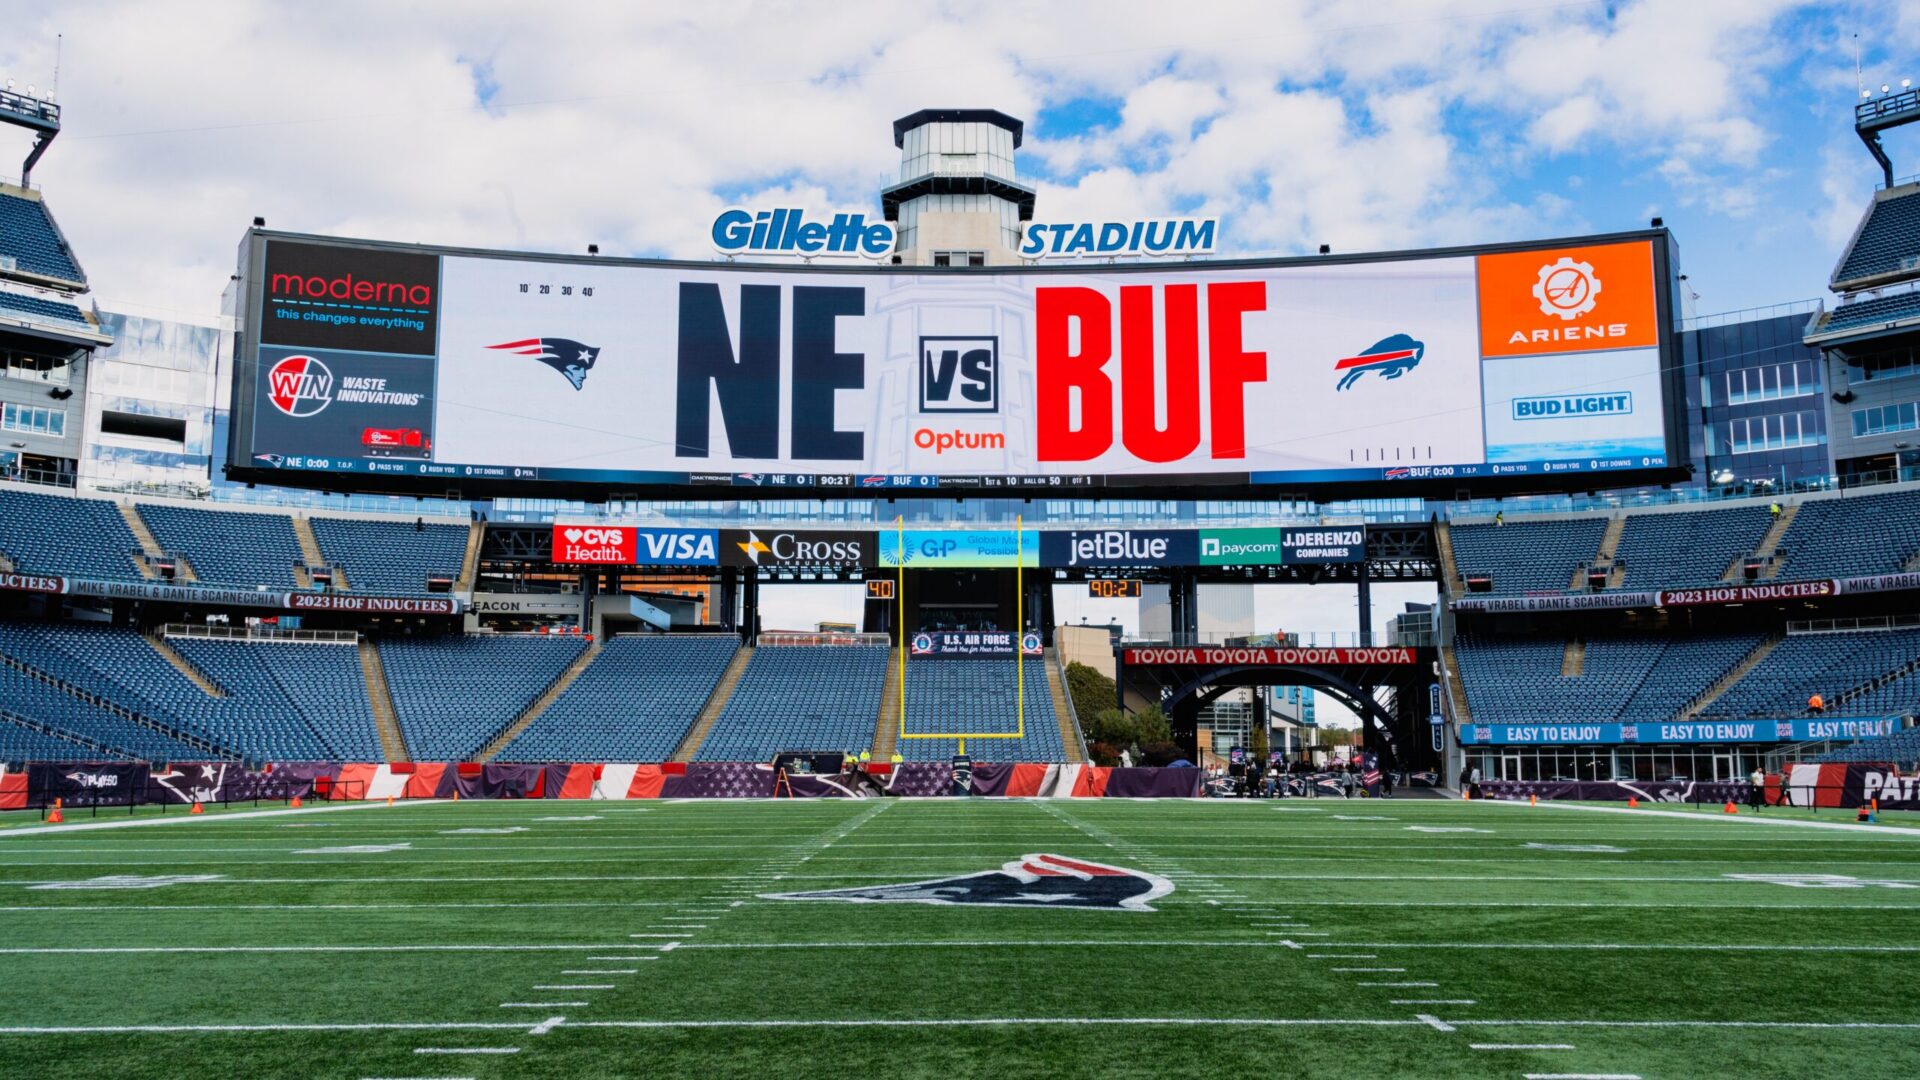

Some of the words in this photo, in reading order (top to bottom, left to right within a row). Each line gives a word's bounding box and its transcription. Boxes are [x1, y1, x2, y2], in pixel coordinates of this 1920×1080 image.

[712, 208, 894, 253] Gillette
[1022, 220, 1217, 255] STADIUM
[272, 273, 431, 305] moderna
[276, 308, 300, 320] this
[303, 312, 357, 325] changes
[360, 317, 425, 331] everything
[1508, 323, 1628, 344] ARIENS
[675, 281, 866, 460] NE
[925, 348, 993, 403] VS
[1036, 281, 1268, 463] BUF
[274, 371, 328, 399] WIN
[342, 376, 387, 391] WASTE
[336, 388, 419, 406] INNOVATIONS
[1516, 400, 1562, 417] BUD
[1565, 395, 1628, 414] LIGHT
[914, 428, 1006, 454] Optum
[287, 456, 302, 467] NE
[306, 458, 329, 468] 0:00
[369, 462, 376, 471] 0
[420, 464, 427, 473] 0
[465, 466, 472, 475] 0
[514, 468, 521, 477] 0
[1410, 467, 1431, 477] BUF
[1433, 466, 1454, 476] 0:00
[1492, 465, 1499, 474] 0
[1543, 462, 1551, 472] 0
[1591, 460, 1598, 469] 0
[1643, 457, 1650, 466] 0
[772, 475, 786, 484] NE
[796, 475, 805, 484] 0
[820, 476, 850, 485] 90:21
[893, 476, 912, 485] BUF
[920, 476, 929, 485] 0
[1006, 476, 1017, 485] 10
[1049, 476, 1061, 485] 50
[1086, 476, 1091, 485] 1
[583, 529, 623, 545] CVS
[640, 533, 716, 559] VISA
[967, 535, 999, 544] Global
[1002, 536, 1030, 545] Mae
[1282, 531, 1362, 547] J.DERENZO
[921, 539, 957, 558] GP
[1068, 531, 1168, 566] jetBlue
[1222, 542, 1277, 556] paycom
[1296, 548, 1349, 558] COMPANIES
[77, 580, 105, 594] MIKE
[109, 582, 149, 598] VRABEL
[152, 586, 160, 598] &
[163, 585, 198, 600] DANTE
[202, 589, 276, 605] SCARNECCHIA
[869, 581, 893, 597] 40
[1091, 581, 1140, 597] 90:21
[1667, 591, 1702, 604] 2023
[1705, 588, 1738, 602] HOF
[1742, 582, 1829, 599] INDUCTEES
[1849, 576, 1876, 592] MIKE
[296, 594, 331, 608] 2023
[333, 596, 364, 610] HOF
[367, 597, 448, 612] INDUCTEES
[1460, 600, 1485, 610] MIKE
[1488, 599, 1525, 611] VRABEL
[1528, 599, 1535, 609] &
[1538, 597, 1570, 609] DANTE
[1574, 594, 1647, 608] SCARNECCHIA
[944, 634, 962, 645] U.S.
[965, 634, 980, 645] AIR
[983, 634, 1010, 645] FORCE
[1132, 649, 1197, 664] TOYOTA
[1203, 649, 1268, 664] TOYOTA
[1274, 649, 1339, 664] TOYOTA
[1345, 649, 1411, 664] TOYOTA
[1507, 727, 1538, 741] EASY
[1541, 727, 1558, 741] TO
[1560, 726, 1601, 741] ENJOY
[1661, 725, 1687, 740] EASY
[1698, 724, 1714, 739] TO
[1717, 724, 1755, 739] ENJOY
[1808, 722, 1839, 737] EASY
[1864, 772, 1920, 801] PAT
